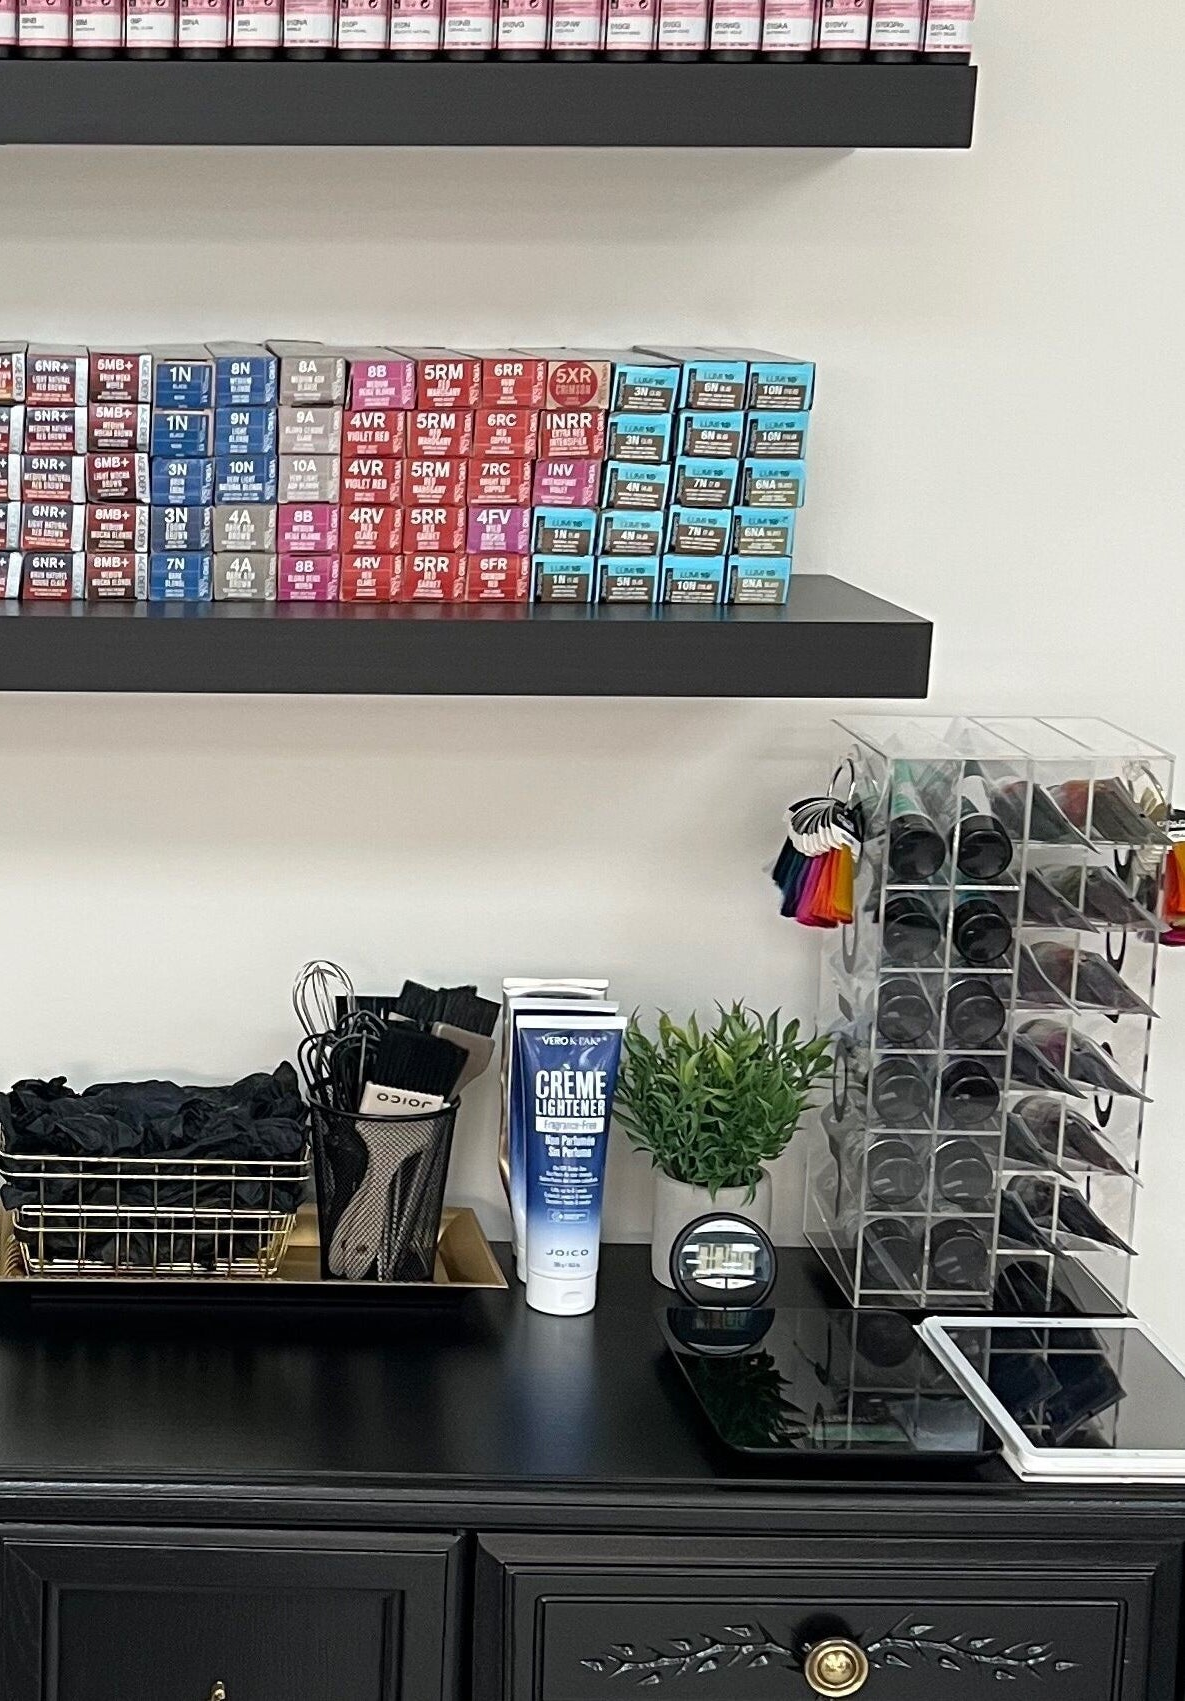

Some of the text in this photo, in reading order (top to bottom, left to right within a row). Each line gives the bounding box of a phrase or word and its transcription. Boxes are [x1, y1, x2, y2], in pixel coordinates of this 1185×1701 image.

[169, 367, 192, 382] 1N
[367, 365, 387, 377] 8B
[424, 364, 463, 380] 5RM
[495, 364, 523, 376] 6RR
[556, 367, 592, 383] 5XR
[166, 416, 188, 431] 1N
[230, 412, 250, 425] 9N
[296, 412, 314, 423] 9A
[350, 412, 386, 428] 4VR
[417, 414, 455, 429] 5RM
[488, 414, 517, 426] 6RC
[546, 413, 593, 428] INRR
[168, 464, 187, 476] 3N
[229, 462, 253, 473] 10N
[293, 460, 316, 472] 10A
[348, 460, 383, 476] 4VR
[411, 462, 450, 477] 5RM
[481, 464, 510, 475] 7RC
[548, 464, 574, 476] INV
[165, 508, 188, 523] 3N
[229, 508, 252, 523] 4A
[294, 511, 313, 523] 8B
[349, 508, 384, 524] 4RV
[410, 509, 447, 524] 5RR
[476, 509, 511, 525] 4FV
[167, 558, 185, 570] 7N
[230, 558, 252, 572] 4A
[295, 561, 313, 573] 8B
[353, 557, 381, 569] 4RV
[413, 557, 449, 572] 5RR
[479, 558, 507, 570] 6FR
[542, 1036, 569, 1046] VERO
[535, 1063, 606, 1099] CRÈME
[377, 1093, 432, 1108] JOICO
[535, 1099, 605, 1116] LIGHTENER
[546, 1249, 589, 1257] JOICO
